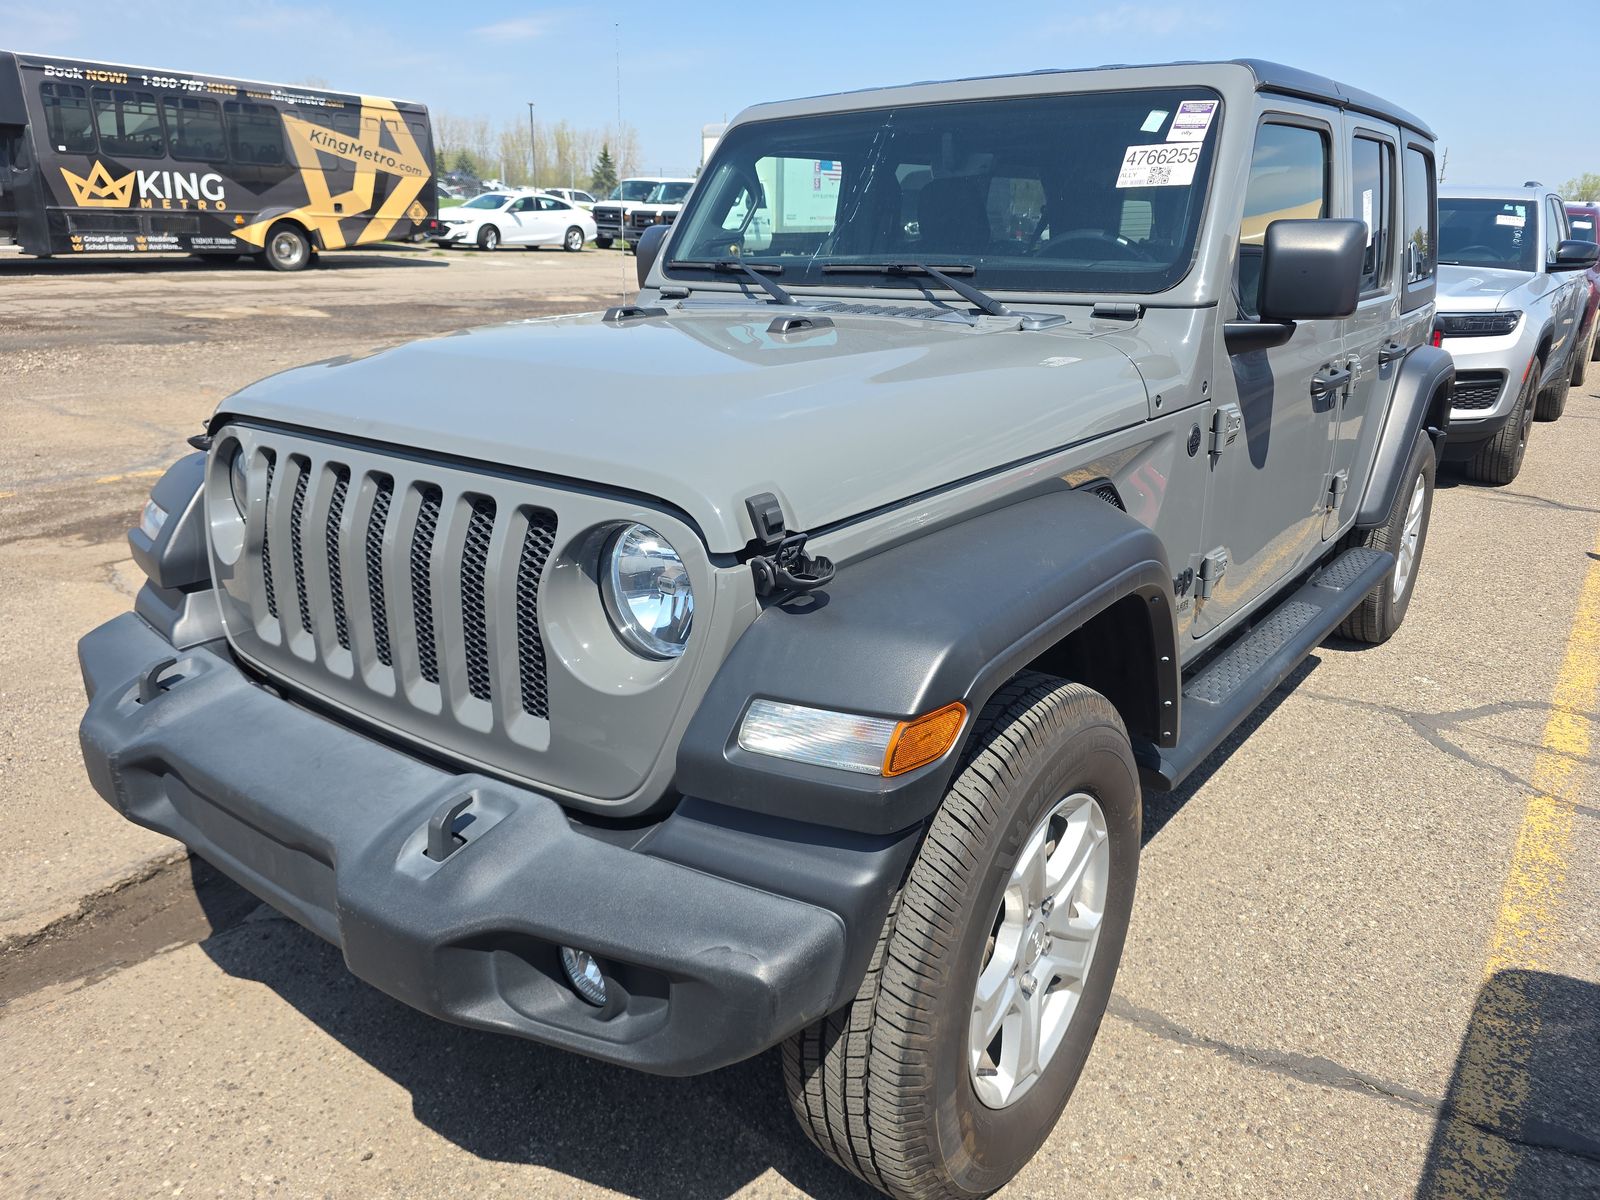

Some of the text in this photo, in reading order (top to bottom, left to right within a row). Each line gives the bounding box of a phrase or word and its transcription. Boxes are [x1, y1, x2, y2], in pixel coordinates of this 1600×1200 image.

[44, 65, 128, 85] Book NOW!
[309, 128, 422, 176] KingMetro.com
[1126, 147, 1199, 166] 4766255
[136, 169, 225, 201] KING
[140, 198, 227, 211] METRO
[83, 236, 104, 244] Group
